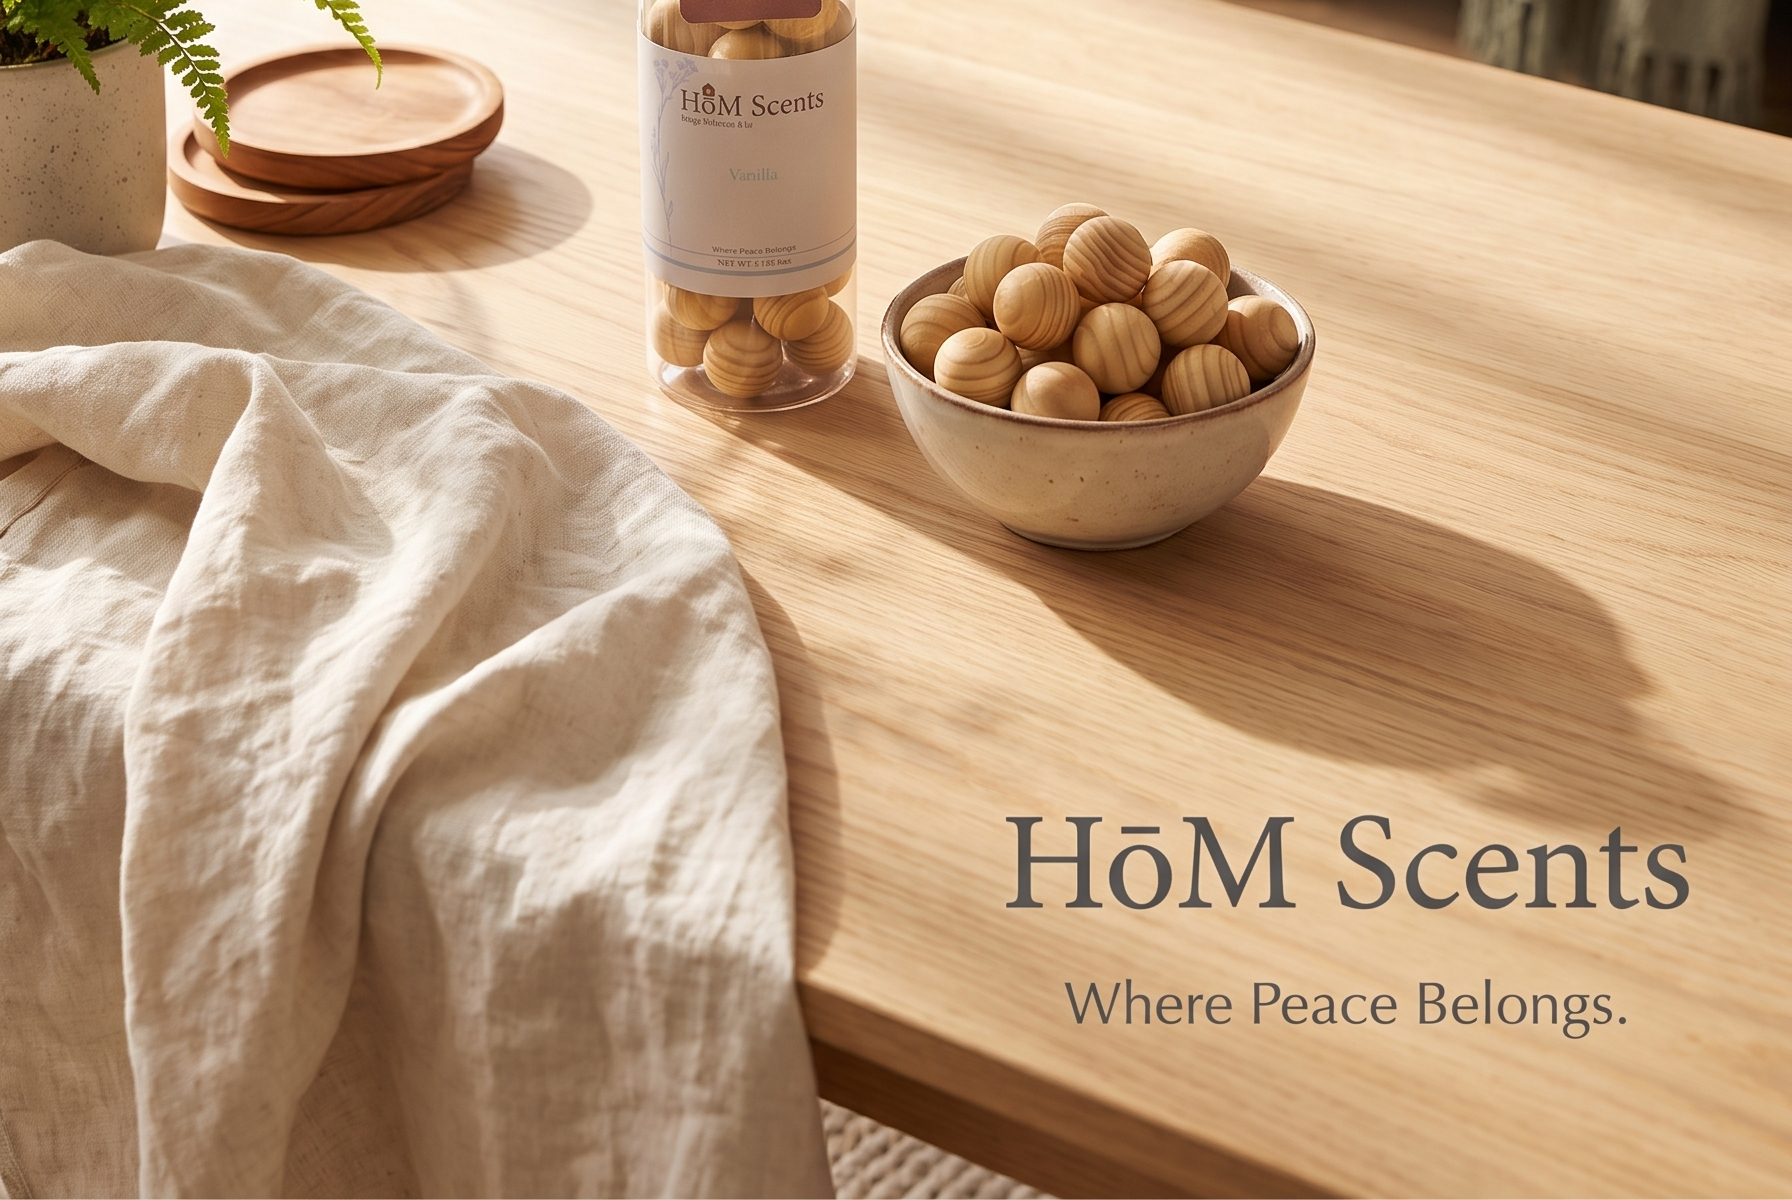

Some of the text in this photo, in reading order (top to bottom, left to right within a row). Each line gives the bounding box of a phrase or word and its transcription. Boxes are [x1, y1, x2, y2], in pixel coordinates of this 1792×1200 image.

[751, 91, 824, 117] Scents
[729, 168, 778, 181] Vanilla
[711, 246, 738, 255] Where
